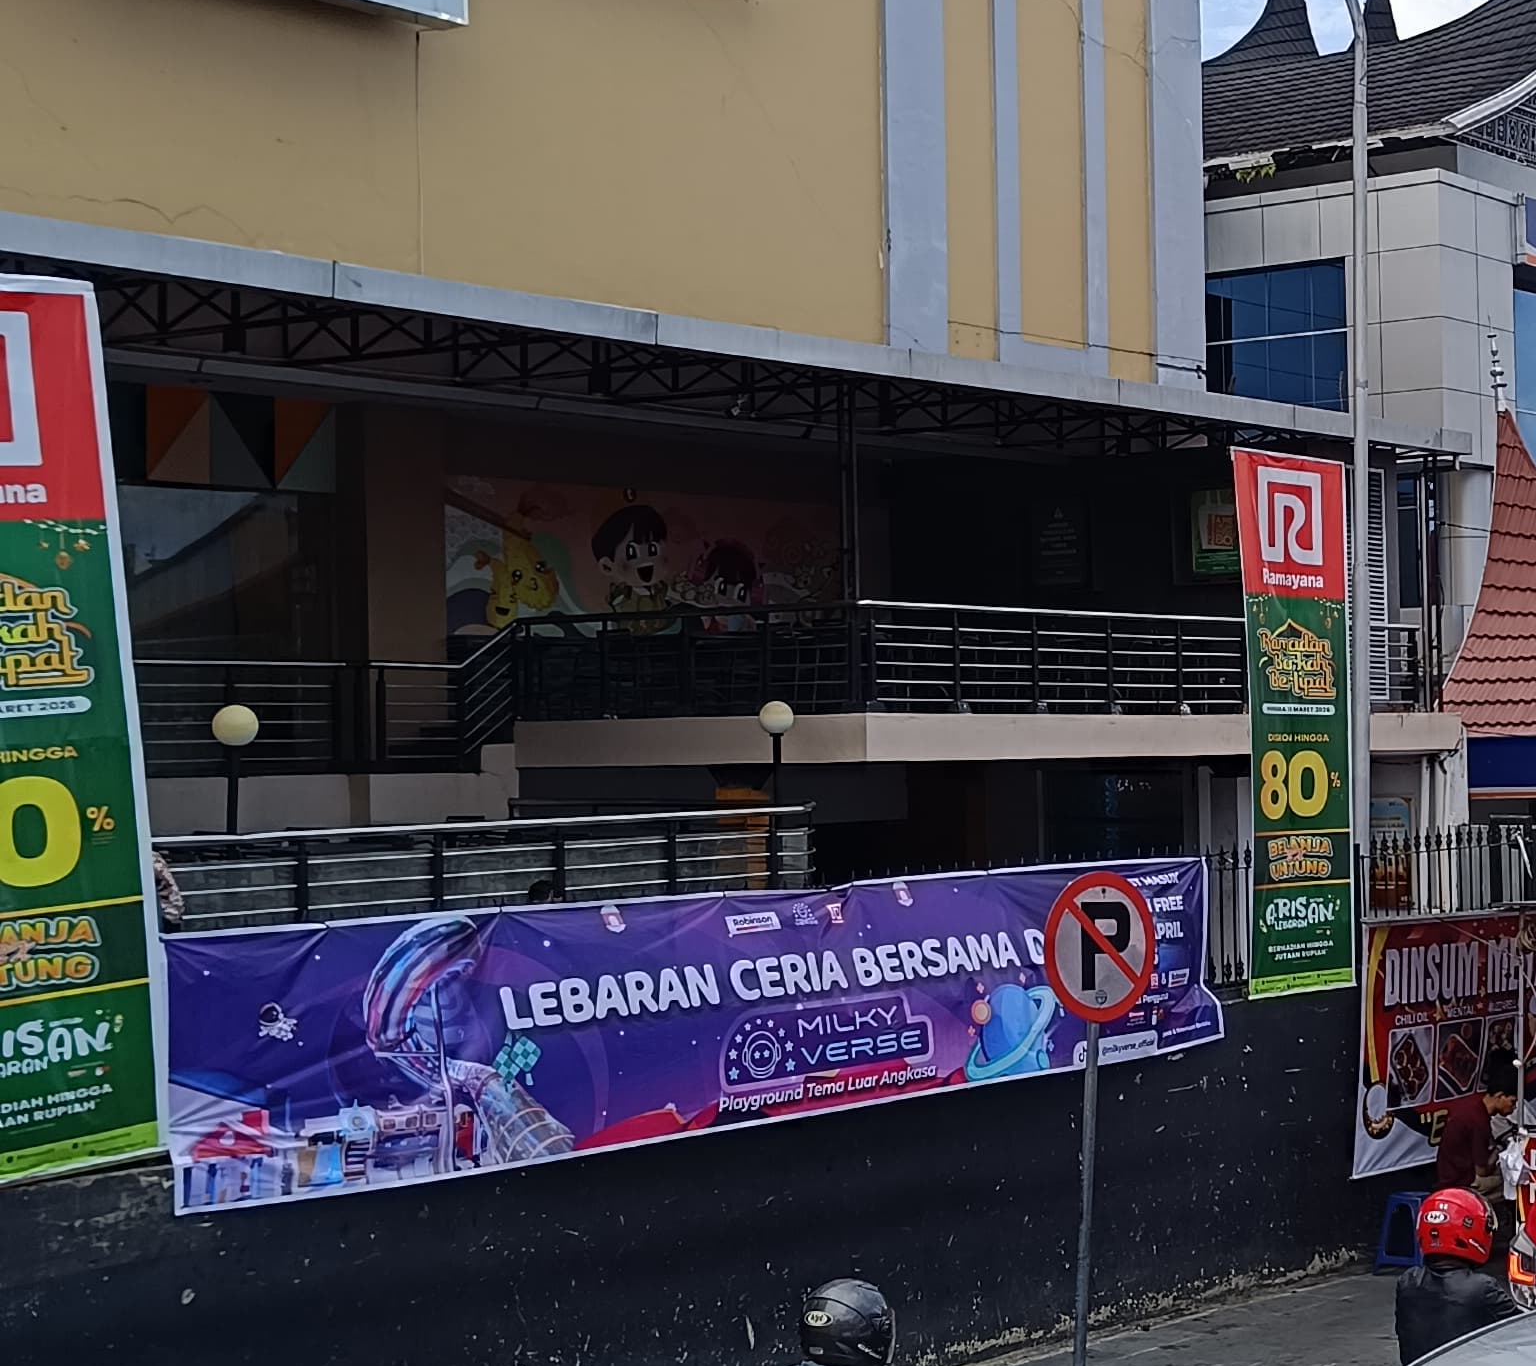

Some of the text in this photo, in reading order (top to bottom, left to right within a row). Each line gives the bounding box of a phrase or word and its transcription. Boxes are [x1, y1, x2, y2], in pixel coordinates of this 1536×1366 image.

[1262, 568, 1325, 590] Ramayana
[1154, 895, 1184, 913] FREE
[1265, 895, 1335, 926] ARISAN
[732, 915, 773, 927] Robinson
[1080, 901, 1131, 992] P
[501, 965, 720, 1030] LEBARAN
[729, 950, 849, 1001] CERIA
[854, 932, 1021, 989] BERSAMA
[1384, 940, 1479, 1006] DINSUM
[797, 1005, 898, 1038] MILKY
[800, 1029, 922, 1066] VERSE
[47, 1083, 114, 1100] HINGGA
[718, 1064, 937, 1112] Playground Tema Luar Angkasa
